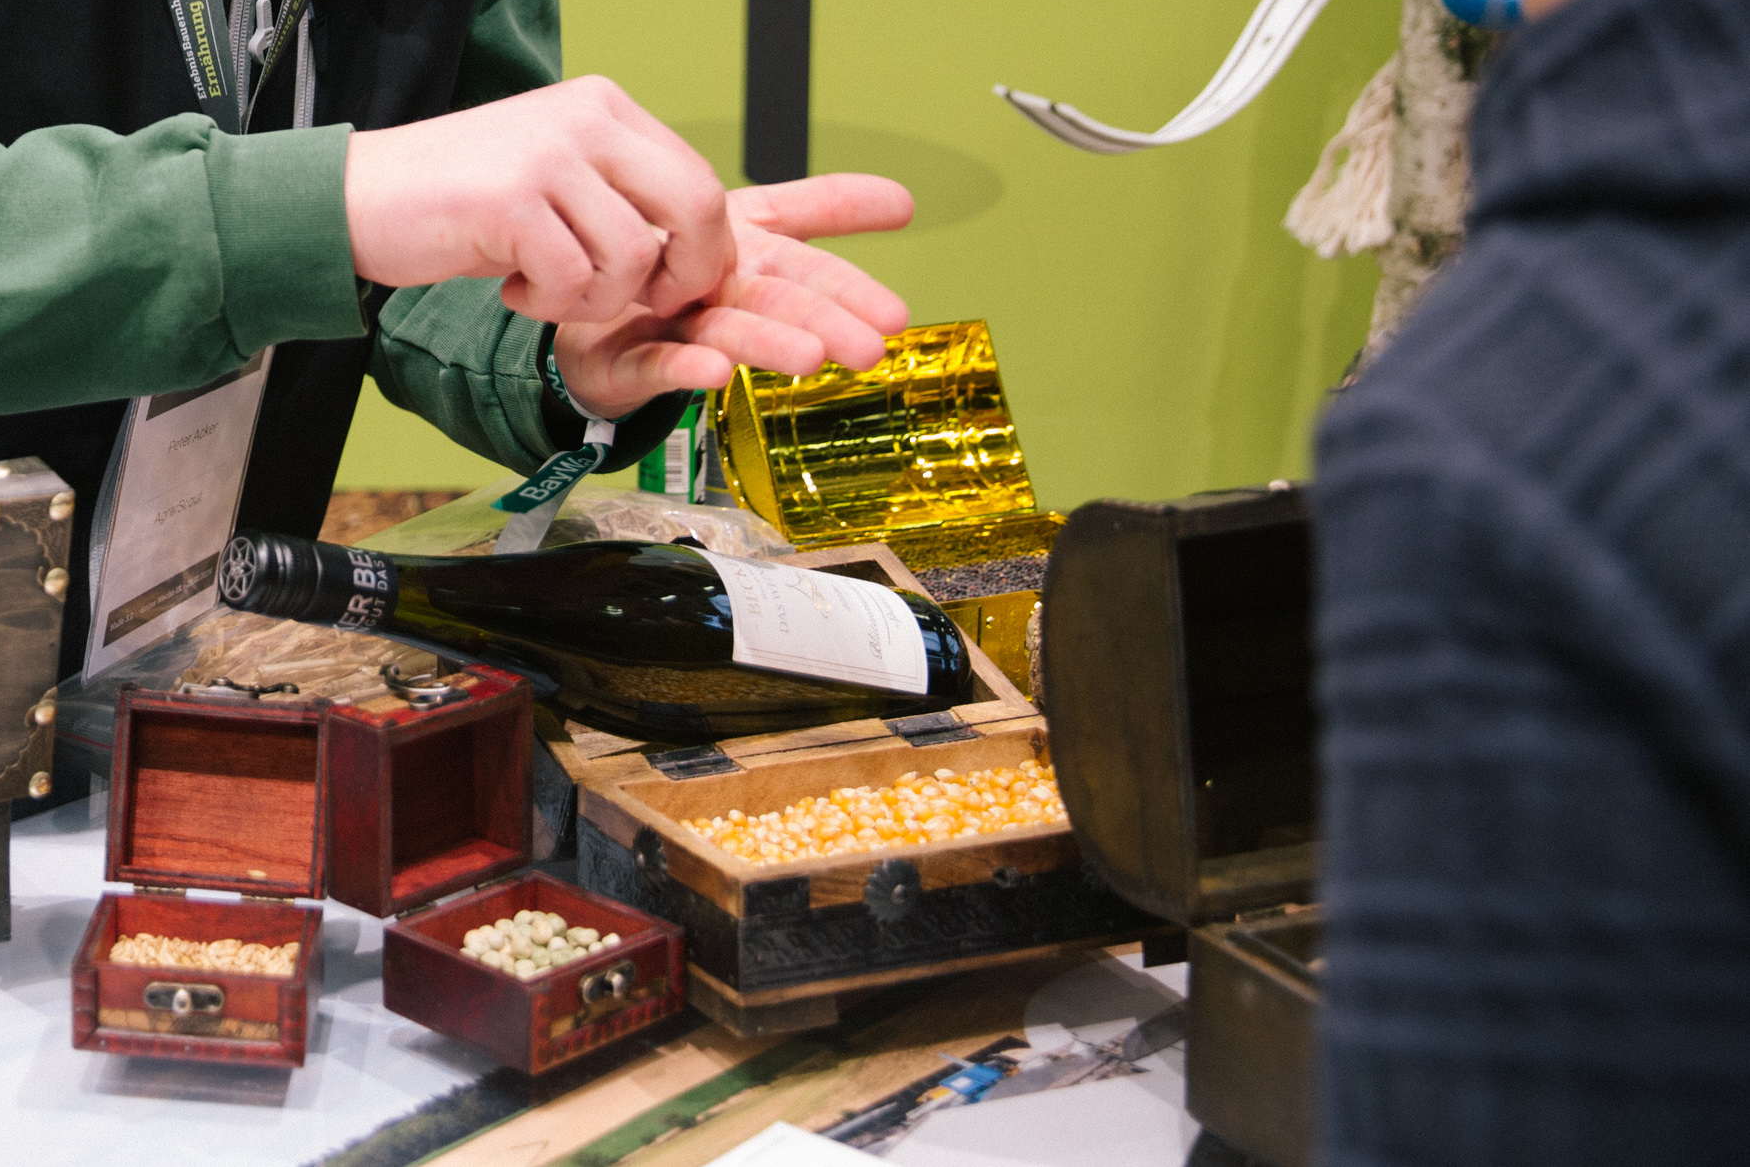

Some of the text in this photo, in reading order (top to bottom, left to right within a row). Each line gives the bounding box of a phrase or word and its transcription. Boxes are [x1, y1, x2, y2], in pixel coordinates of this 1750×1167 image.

[188, 0, 223, 99] Ernährung
[167, 421, 219, 455] Peter Acker
[518, 456, 595, 502] BayWa
[373, 558, 389, 592] DAS
